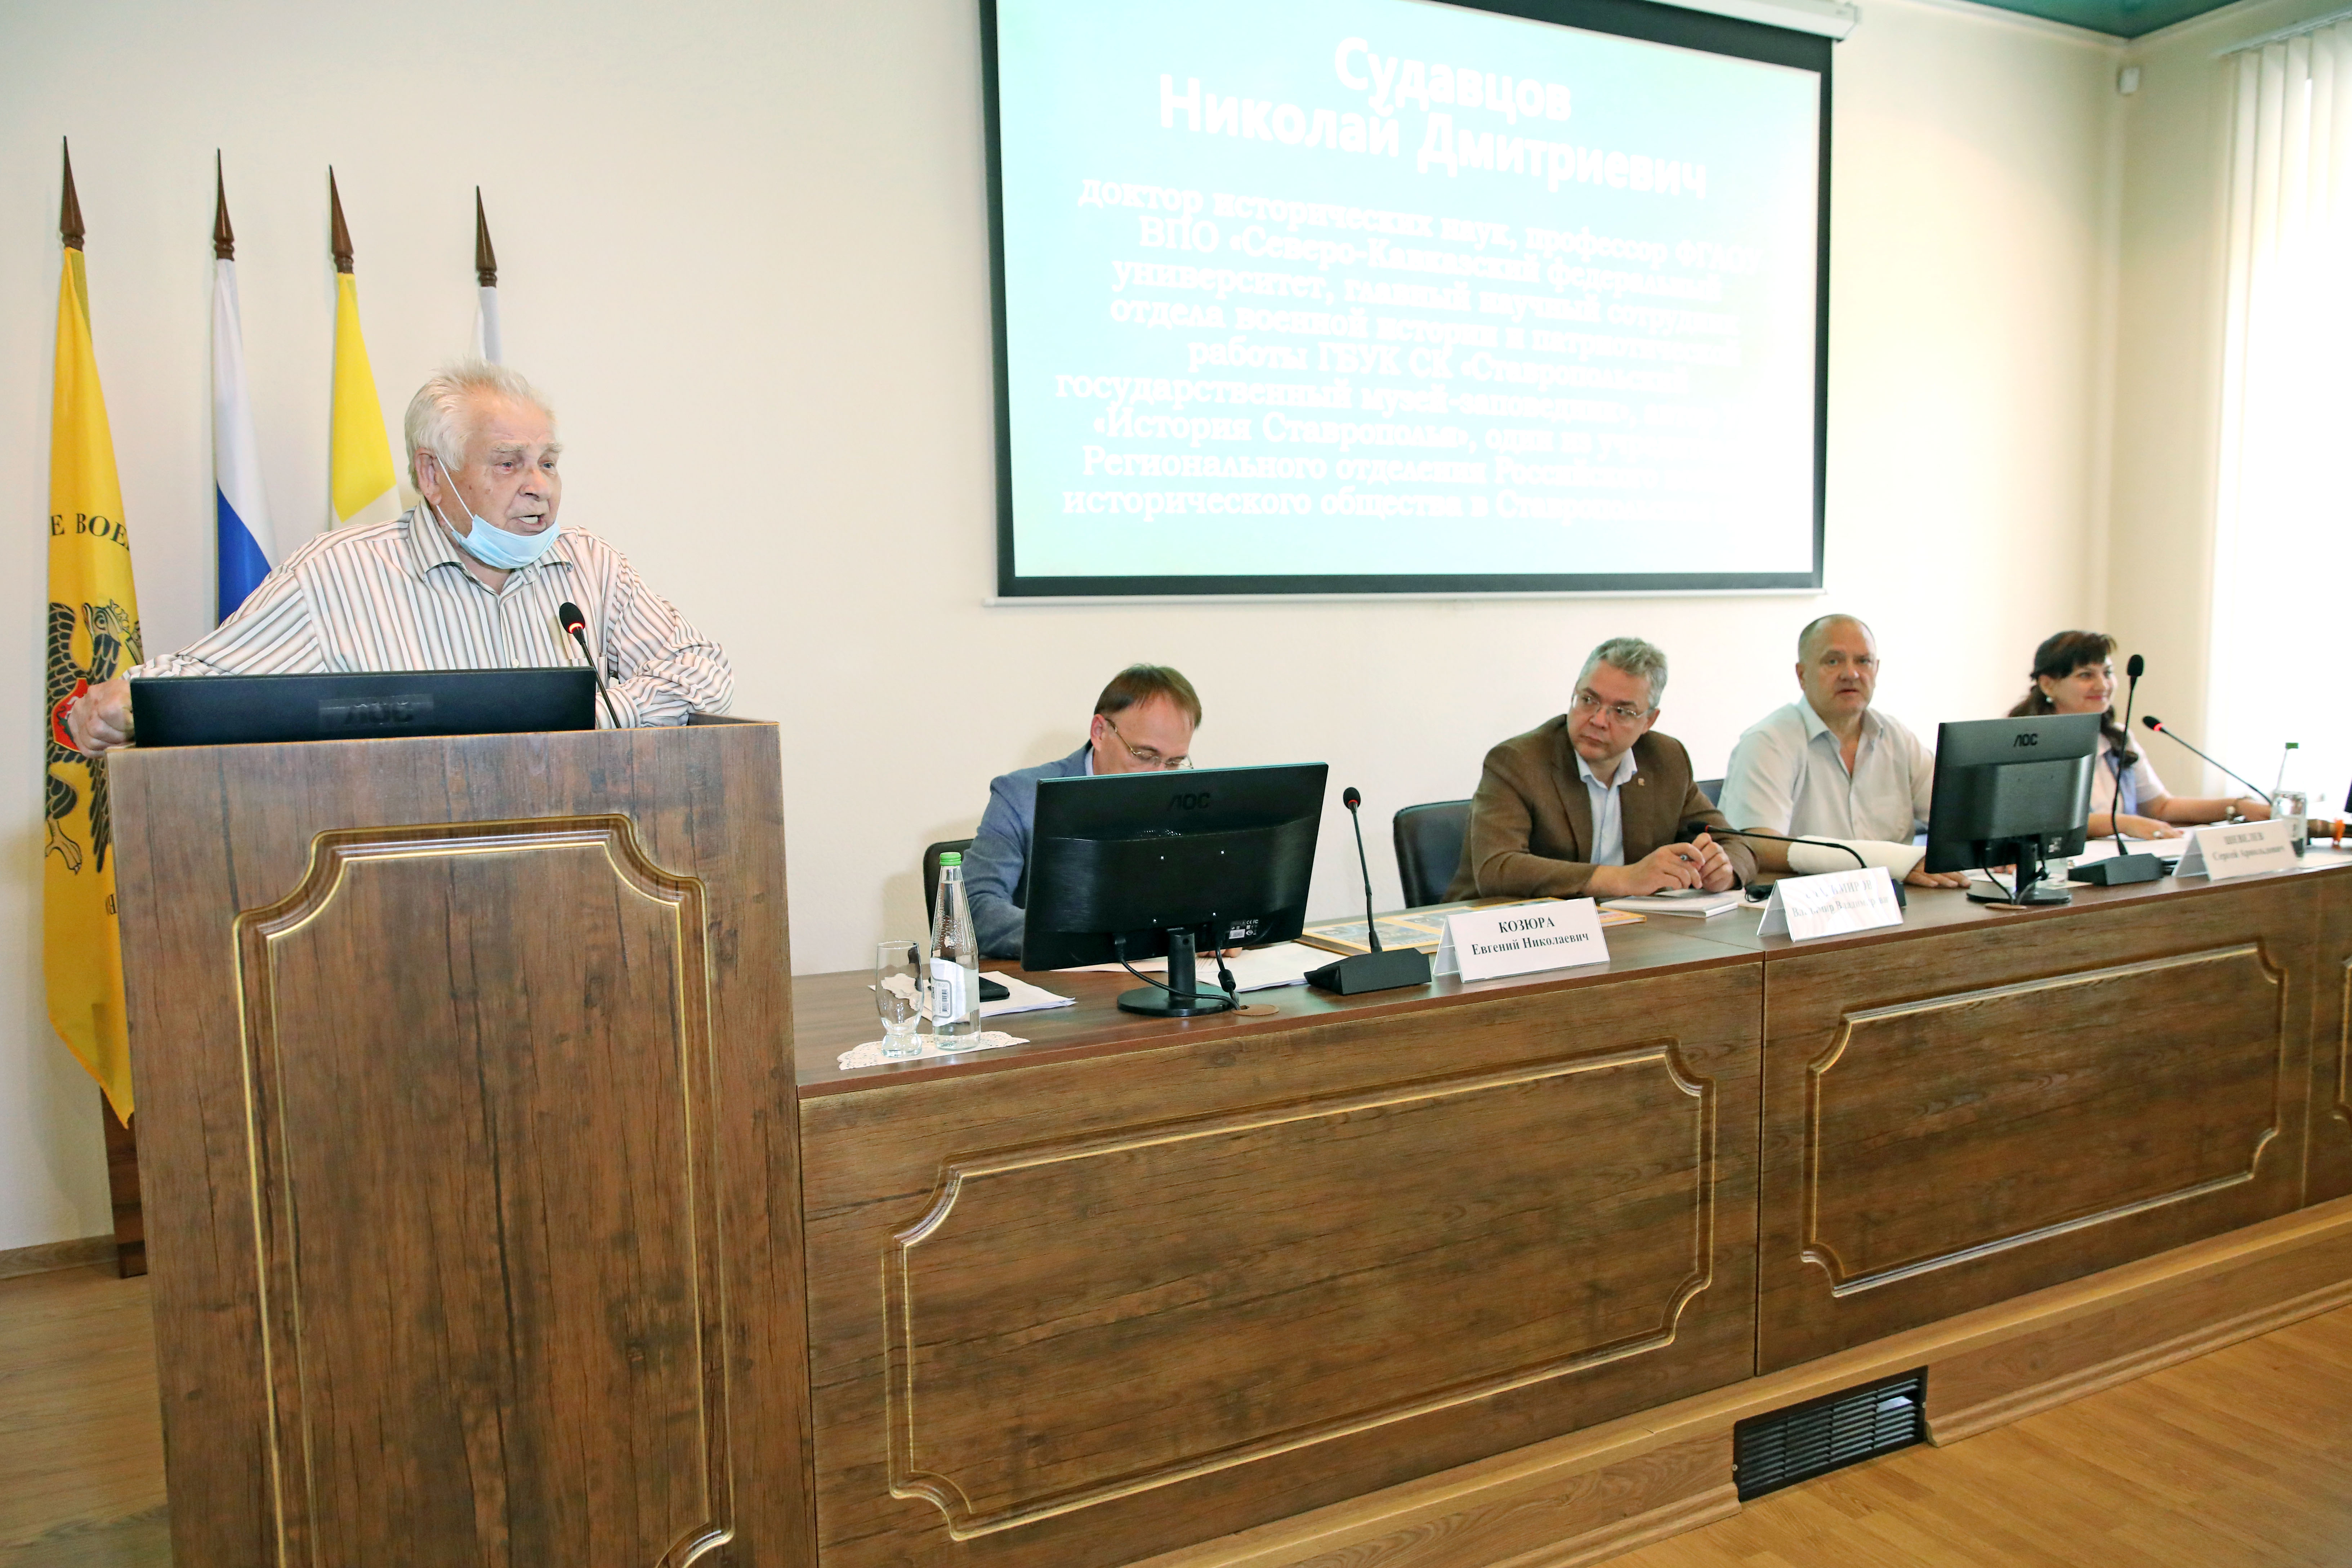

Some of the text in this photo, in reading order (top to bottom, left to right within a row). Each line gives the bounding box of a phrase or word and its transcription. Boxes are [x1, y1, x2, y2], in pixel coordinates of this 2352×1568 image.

[1334, 37, 1571, 124] Судавцов
[1159, 73, 1707, 199] Николай Дмитриевич
[1077, 179, 1203, 221] доктор
[1213, 192, 1433, 237] исторических
[1441, 218, 1517, 251] наук,
[1526, 227, 1668, 271] профессор
[1138, 216, 1723, 301] ВПО «Северо-Кавказский федеральный
[1111, 260, 1334, 305] университет,
[1344, 278, 1471, 311] главный
[1479, 290, 1601, 322] научный
[1110, 298, 1226, 330] отдела
[1235, 307, 1369, 338] военной
[1376, 316, 1498, 350] истории
[1506, 326, 1525, 349] и
[1187, 335, 1308, 372] работы
[1317, 341, 1401, 376] ГБУК
[1408, 347, 1453, 380] СК
[1054, 374, 1352, 409] государственный
[1093, 405, 1252, 447] «История
[1262, 411, 1477, 453] Ставрополья»,
[1485, 429, 1553, 454] один
[1081, 445, 1327, 478] Регионального
[1335, 457, 1487, 486] отделения
[1062, 491, 1312, 521] исторического
[1321, 486, 1463, 519] общества
[1471, 497, 1489, 517] в
[76, 513, 130, 551] ВОЕ
[2013, 733, 2039, 747] AOC
[1169, 793, 1210, 810] AOC
[1472, 933, 1589, 955] Евгений Николаевич
[1498, 916, 1555, 934] КОЗЮРА
